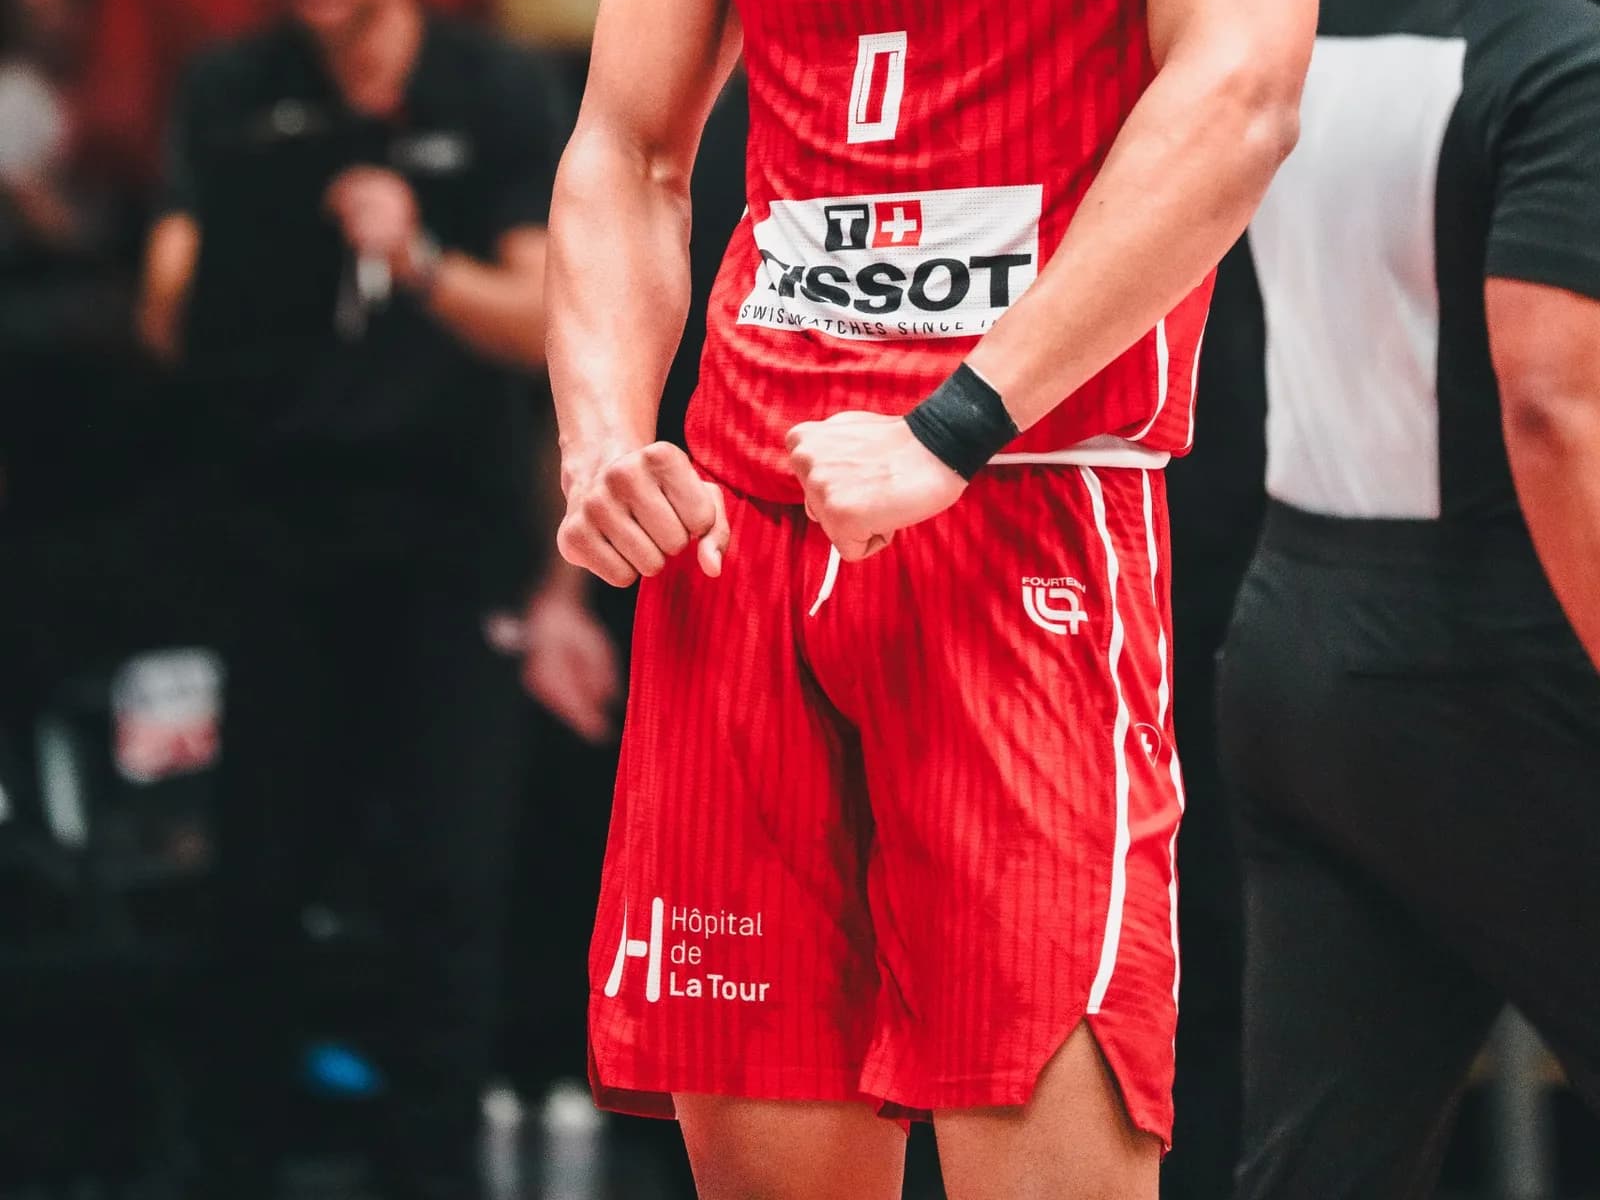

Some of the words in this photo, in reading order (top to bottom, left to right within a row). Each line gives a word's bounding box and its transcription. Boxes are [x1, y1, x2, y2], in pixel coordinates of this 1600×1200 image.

[847, 30, 907, 144] 0
[671, 906, 763, 939] Hôpital
[670, 940, 702, 965] de
[669, 971, 702, 998] La
[707, 973, 770, 1002] Tour
